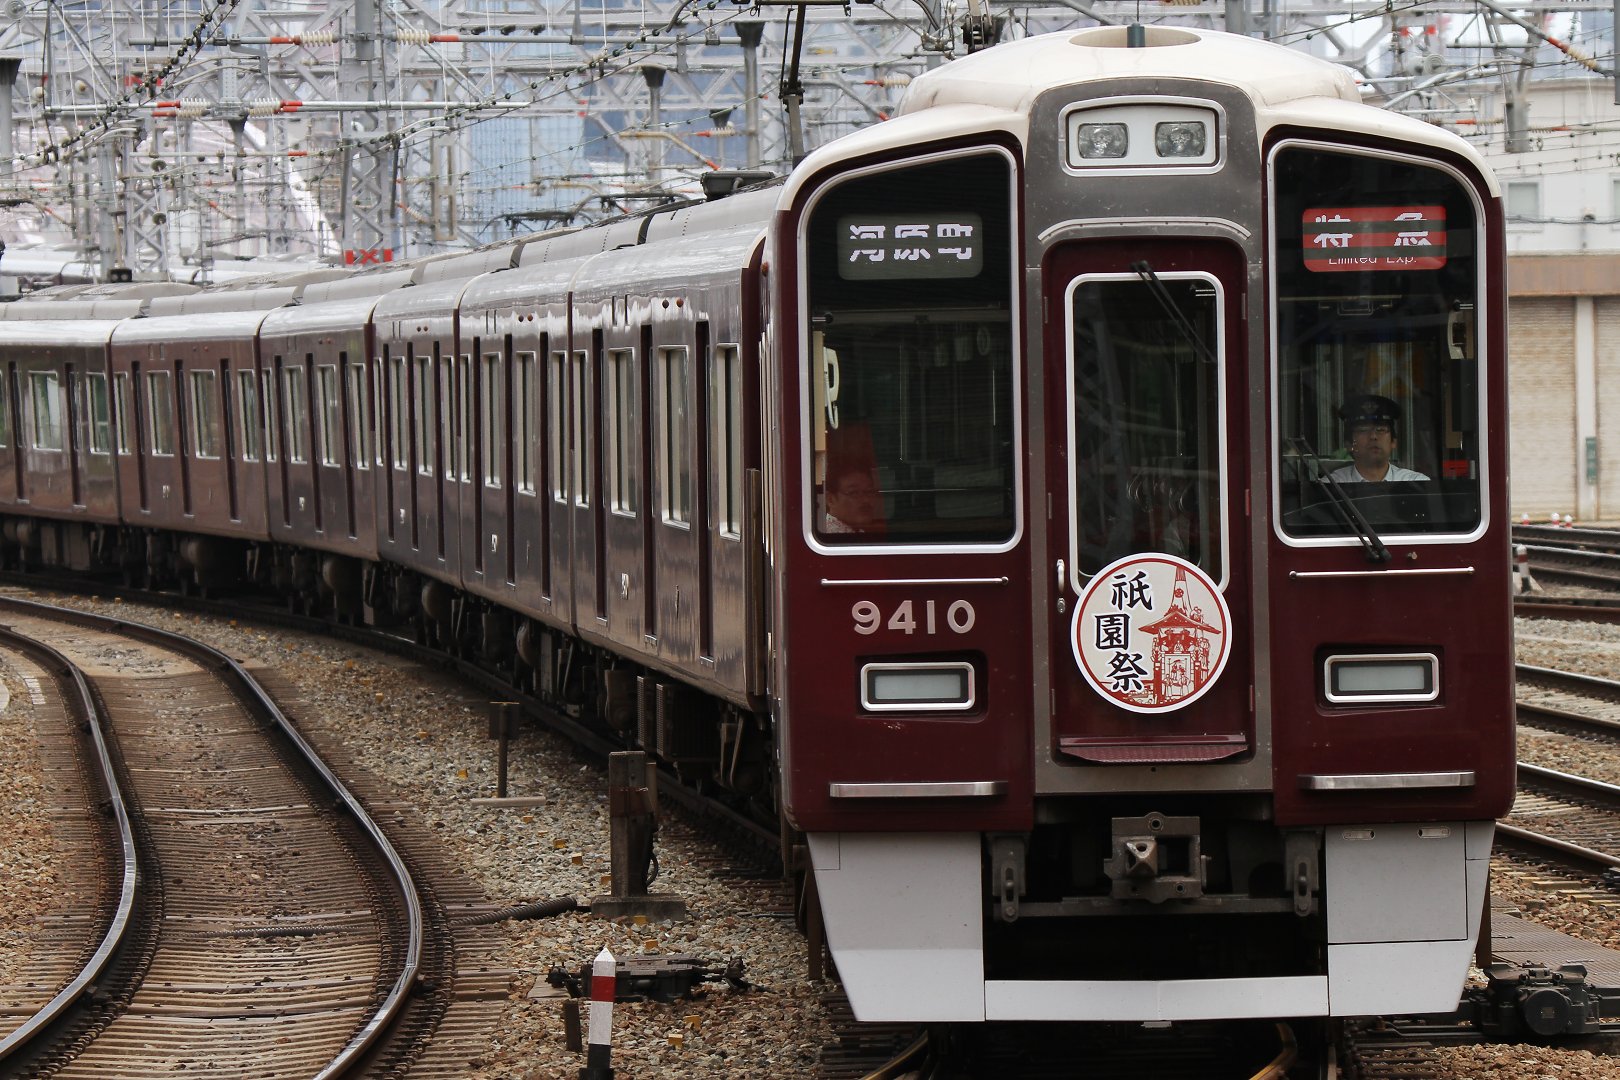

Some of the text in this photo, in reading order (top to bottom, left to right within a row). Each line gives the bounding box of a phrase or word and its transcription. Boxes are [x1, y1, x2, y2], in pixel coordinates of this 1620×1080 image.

[851, 600, 976, 635] 9410
[1094, 570, 1153, 692] 祇園祭
